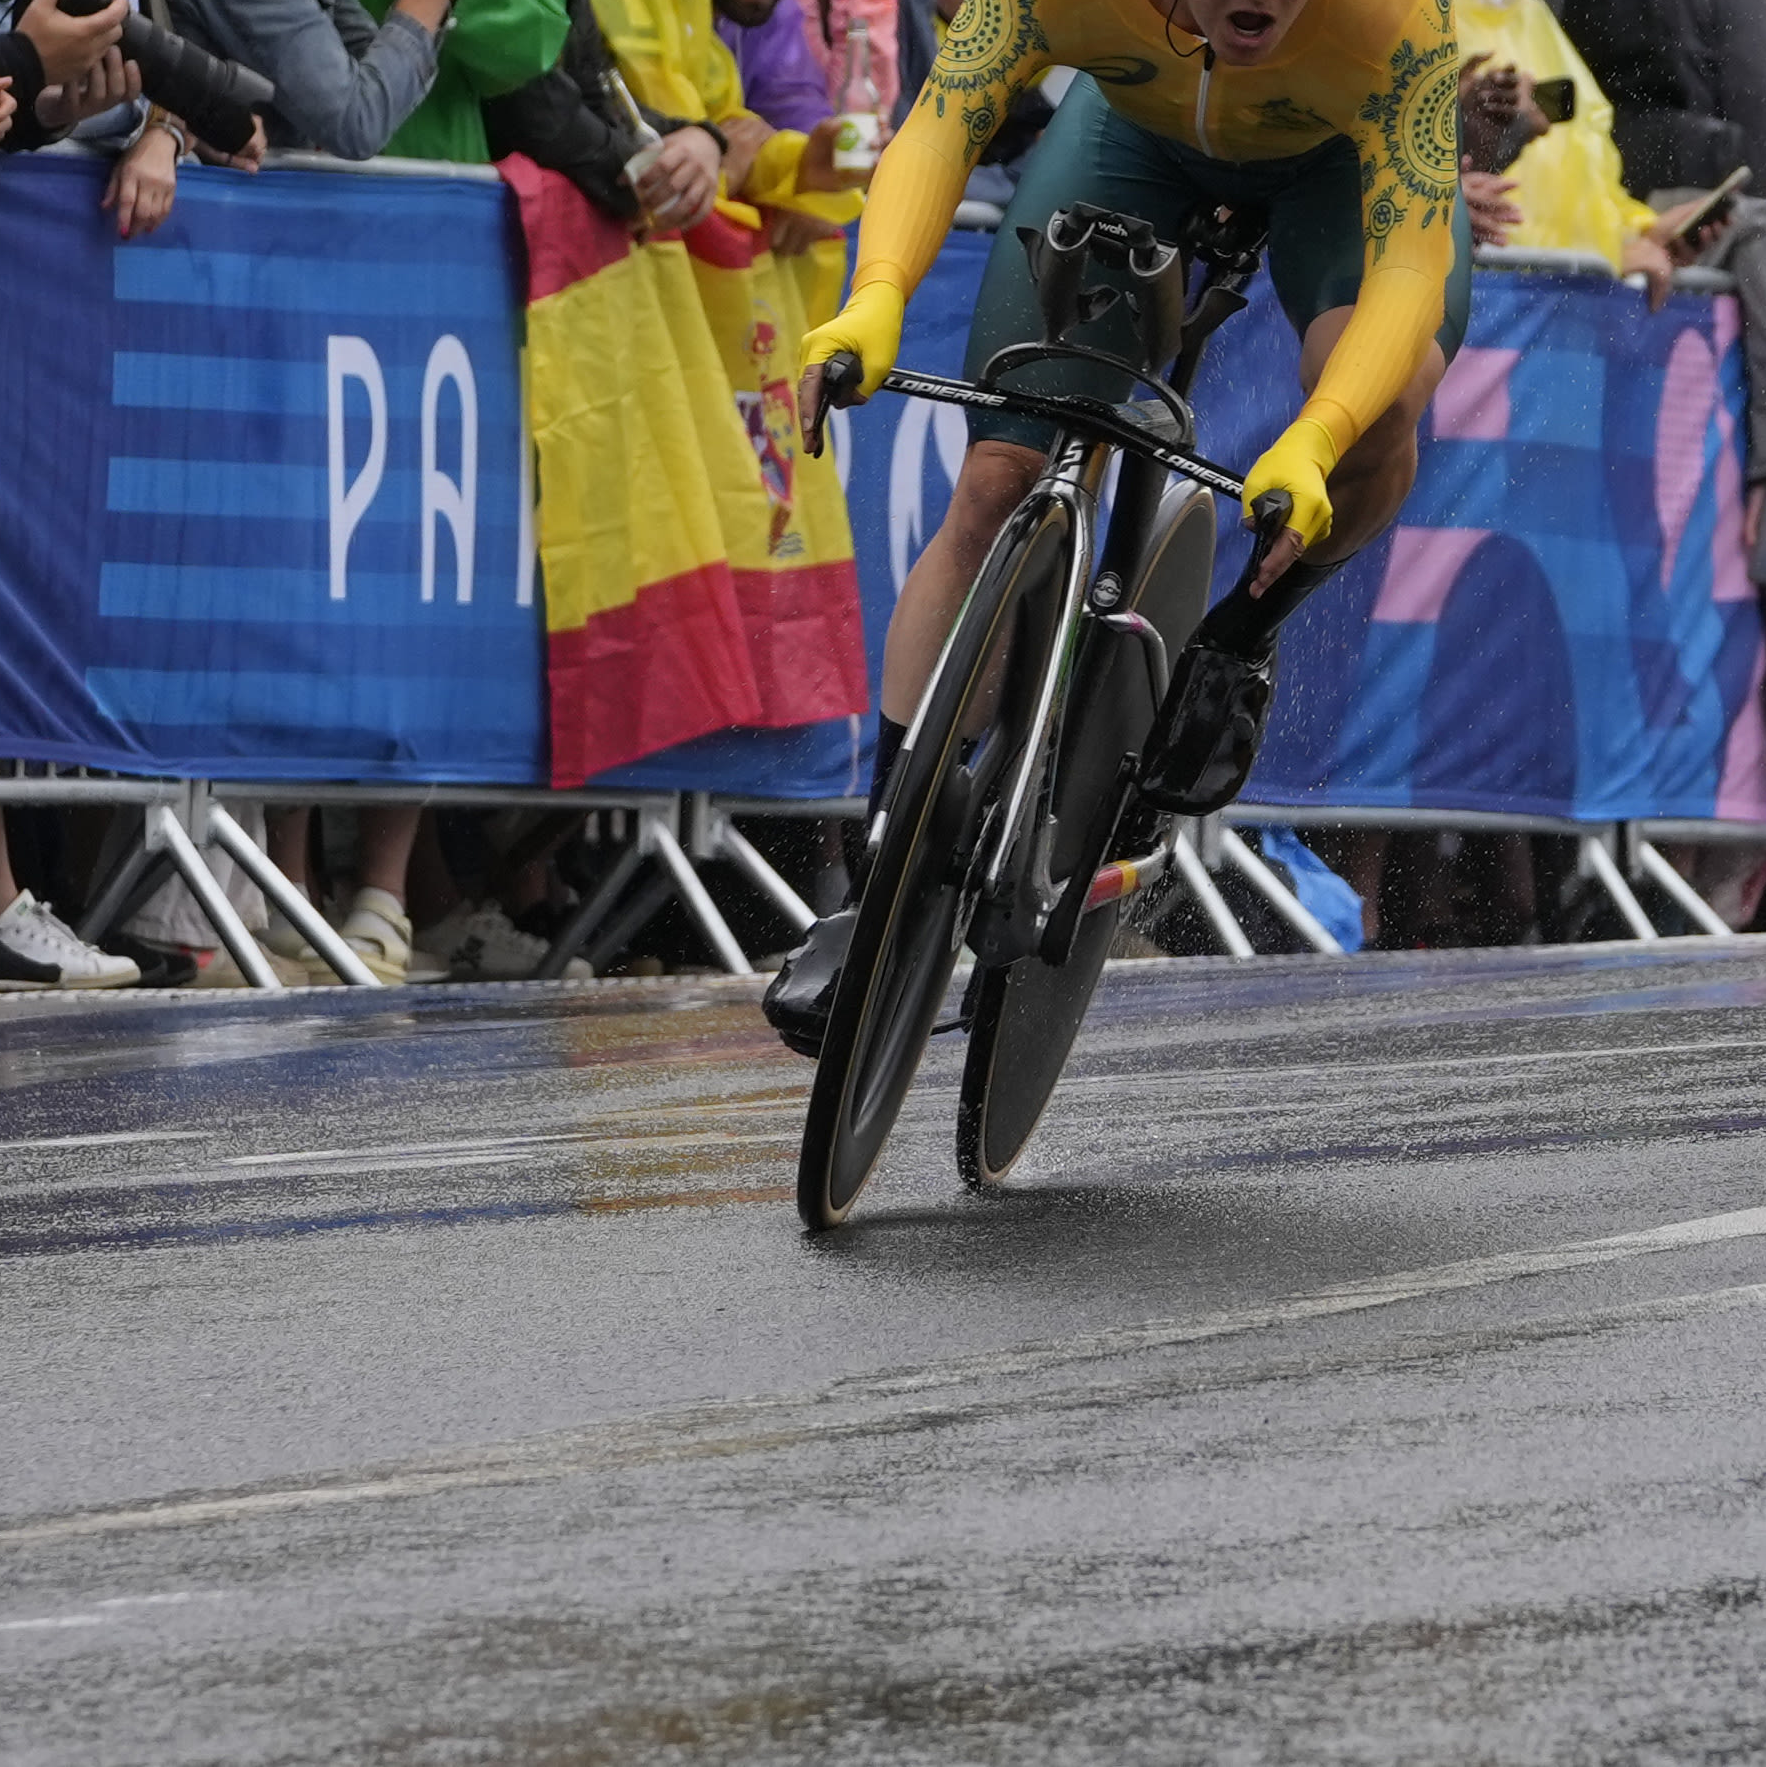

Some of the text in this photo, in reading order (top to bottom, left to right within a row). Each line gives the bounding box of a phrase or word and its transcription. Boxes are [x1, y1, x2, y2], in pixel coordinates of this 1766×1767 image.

[884, 377, 1008, 407] LAPIERRE
[326, 335, 534, 607] PA
[1153, 447, 1244, 495] LAPIERR
